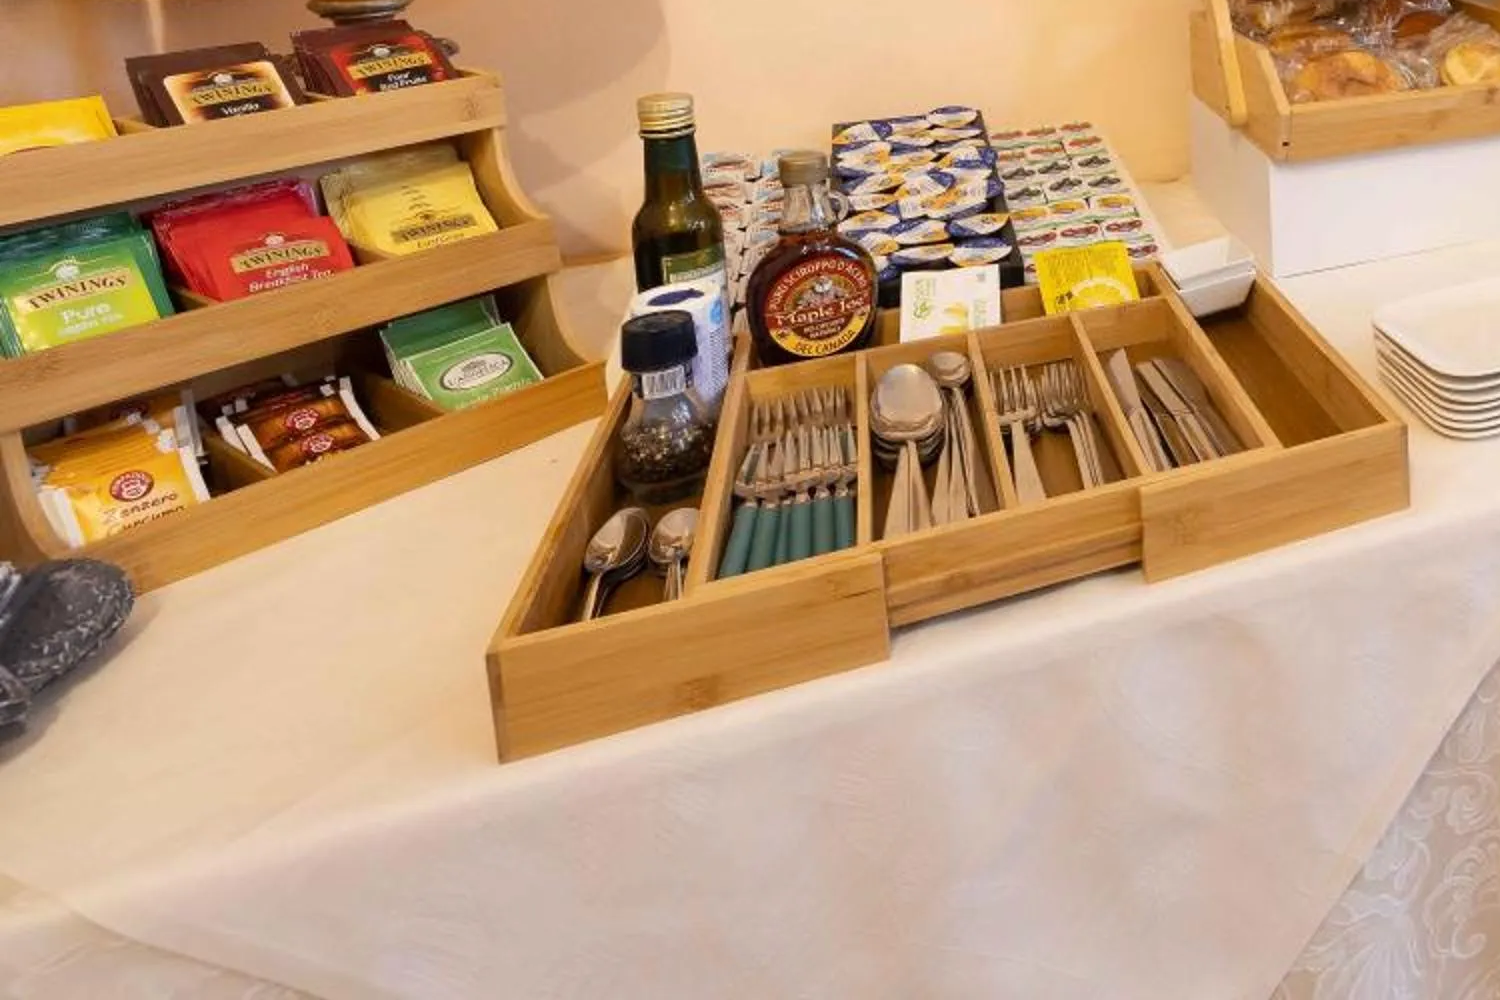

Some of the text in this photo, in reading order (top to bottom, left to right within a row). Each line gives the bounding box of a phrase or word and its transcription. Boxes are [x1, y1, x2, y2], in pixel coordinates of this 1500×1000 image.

[240, 244, 324, 269] TWININGS
[265, 263, 310, 281] English
[28, 274, 127, 310] TWININGS
[815, 329, 856, 354] CANADA
